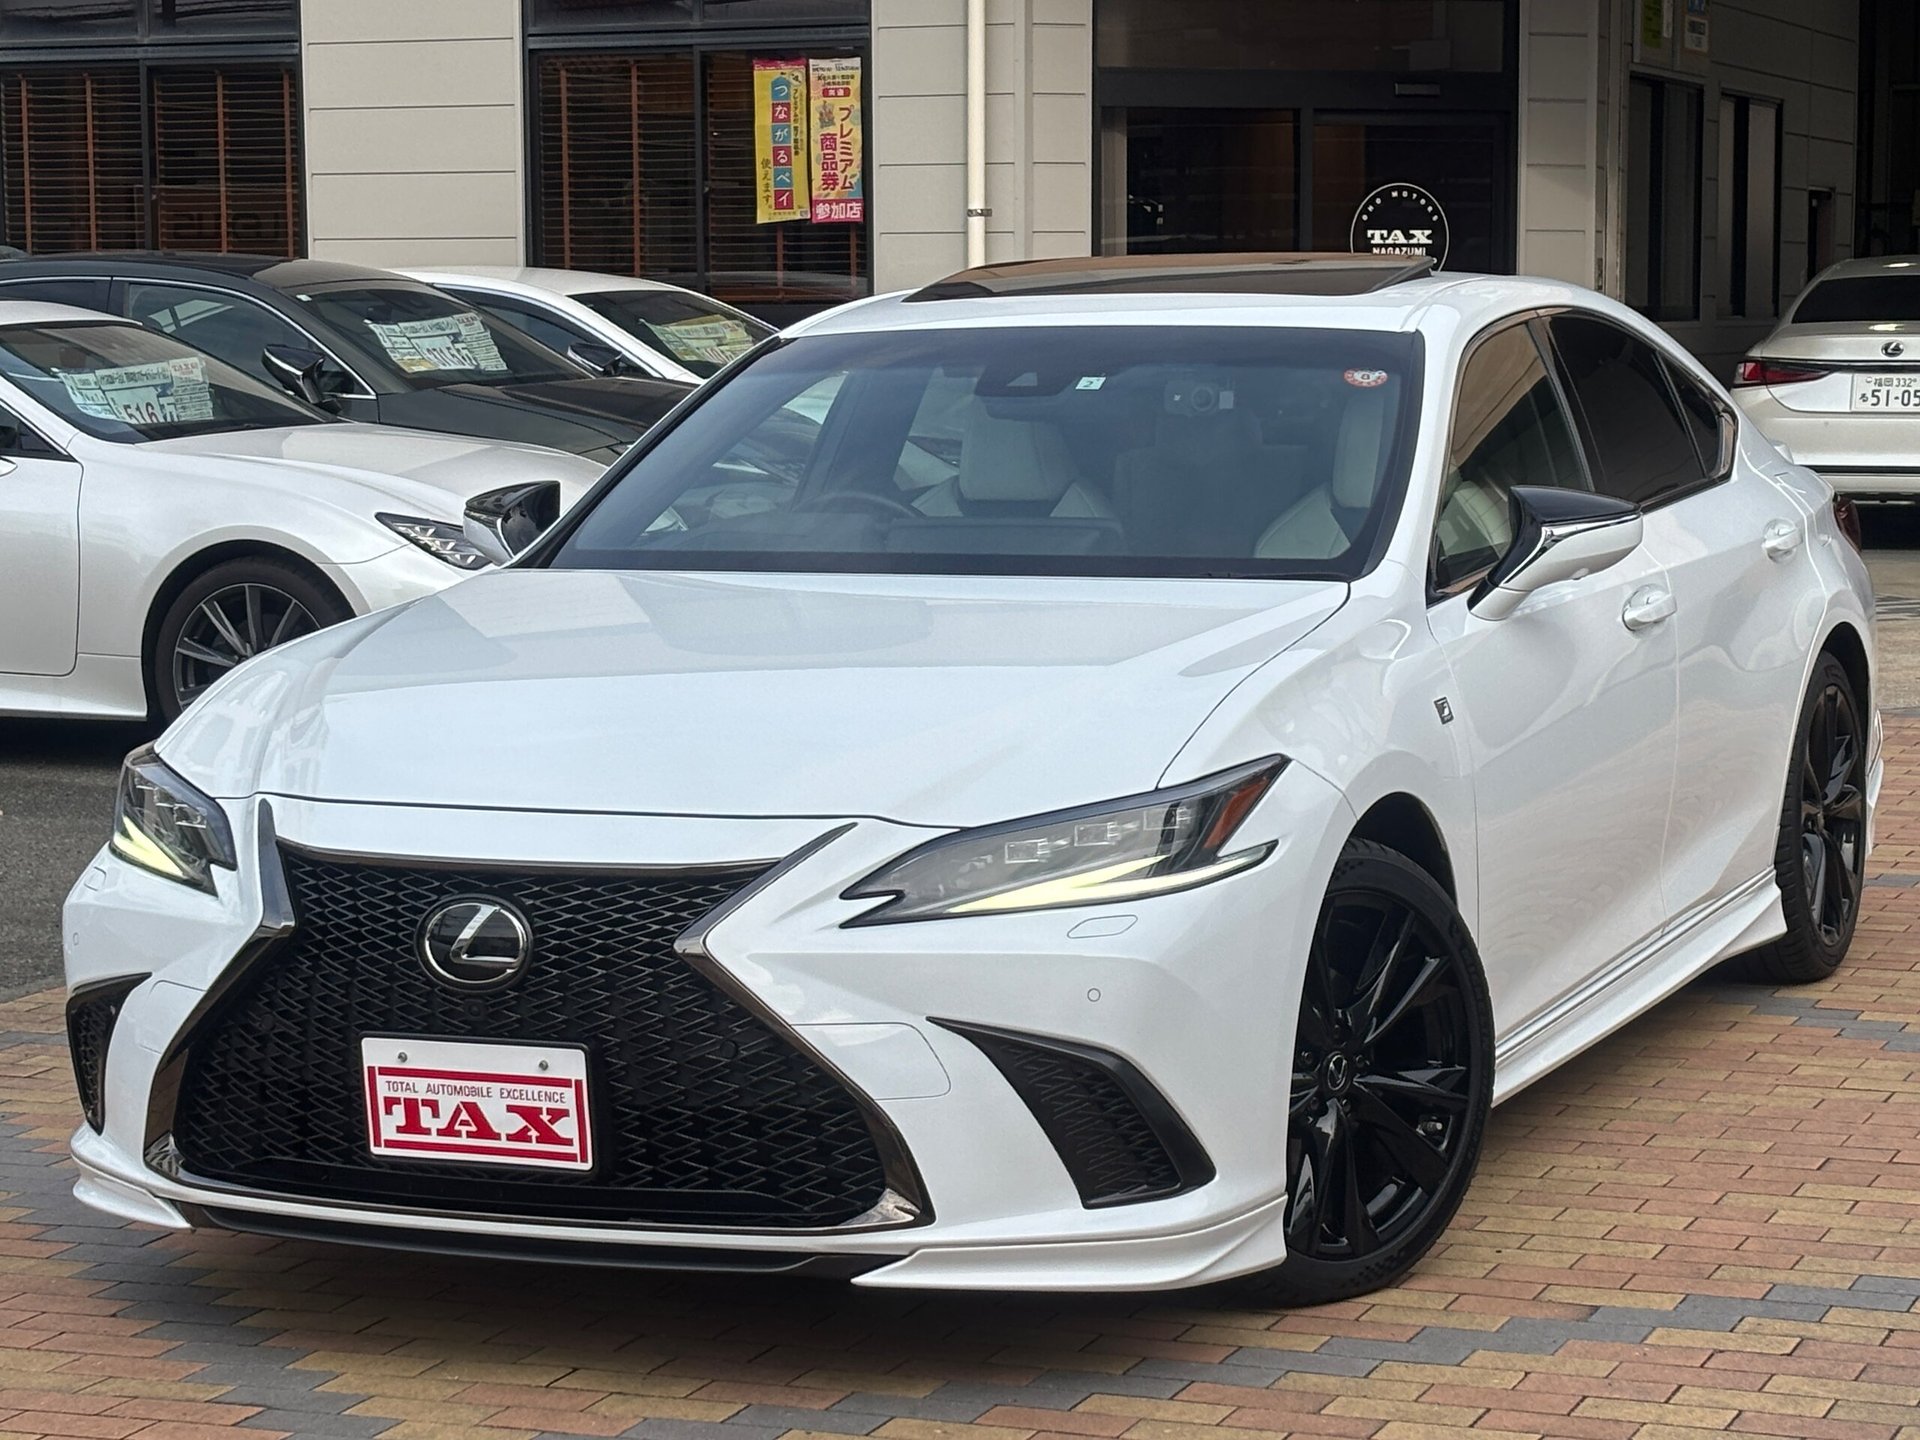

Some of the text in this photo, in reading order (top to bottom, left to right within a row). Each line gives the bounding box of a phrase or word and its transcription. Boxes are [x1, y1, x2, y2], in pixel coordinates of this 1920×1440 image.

[773, 84, 792, 207] つながるペイ
[838, 105, 855, 191] プレミアム
[820, 133, 839, 191] 商品券
[815, 202, 863, 219] 参加店
[1391, 190, 1439, 222] MOTORS
[1366, 229, 1433, 244] TAX
[1372, 246, 1427, 256] NAGAZUMI
[1874, 377, 1912, 387] 福岡 332
[385, 1080, 566, 1104] TOTAL AUTOMOBILE EXCELLENCE
[383, 1096, 575, 1147] TAX
